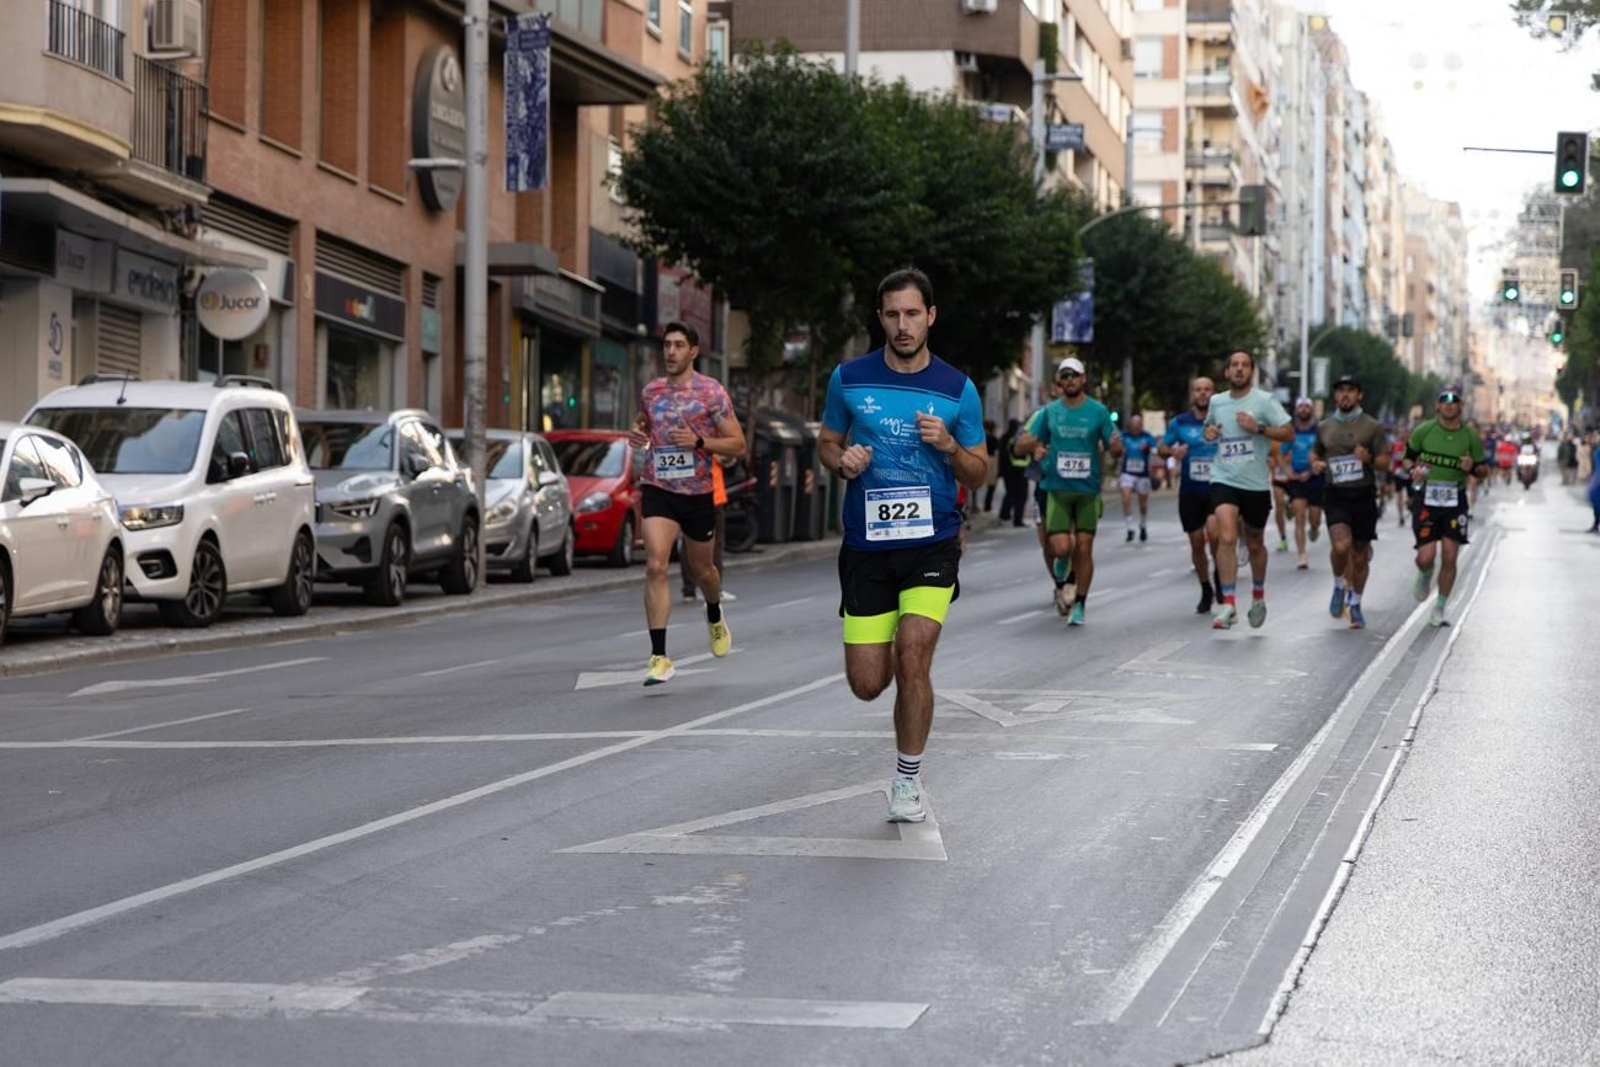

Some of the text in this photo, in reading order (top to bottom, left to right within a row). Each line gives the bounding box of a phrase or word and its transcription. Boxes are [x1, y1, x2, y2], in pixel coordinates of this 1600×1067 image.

[219, 294, 261, 310] Jucar
[659, 454, 687, 467] 324
[1063, 460, 1085, 469] 476
[877, 501, 920, 521] 822
